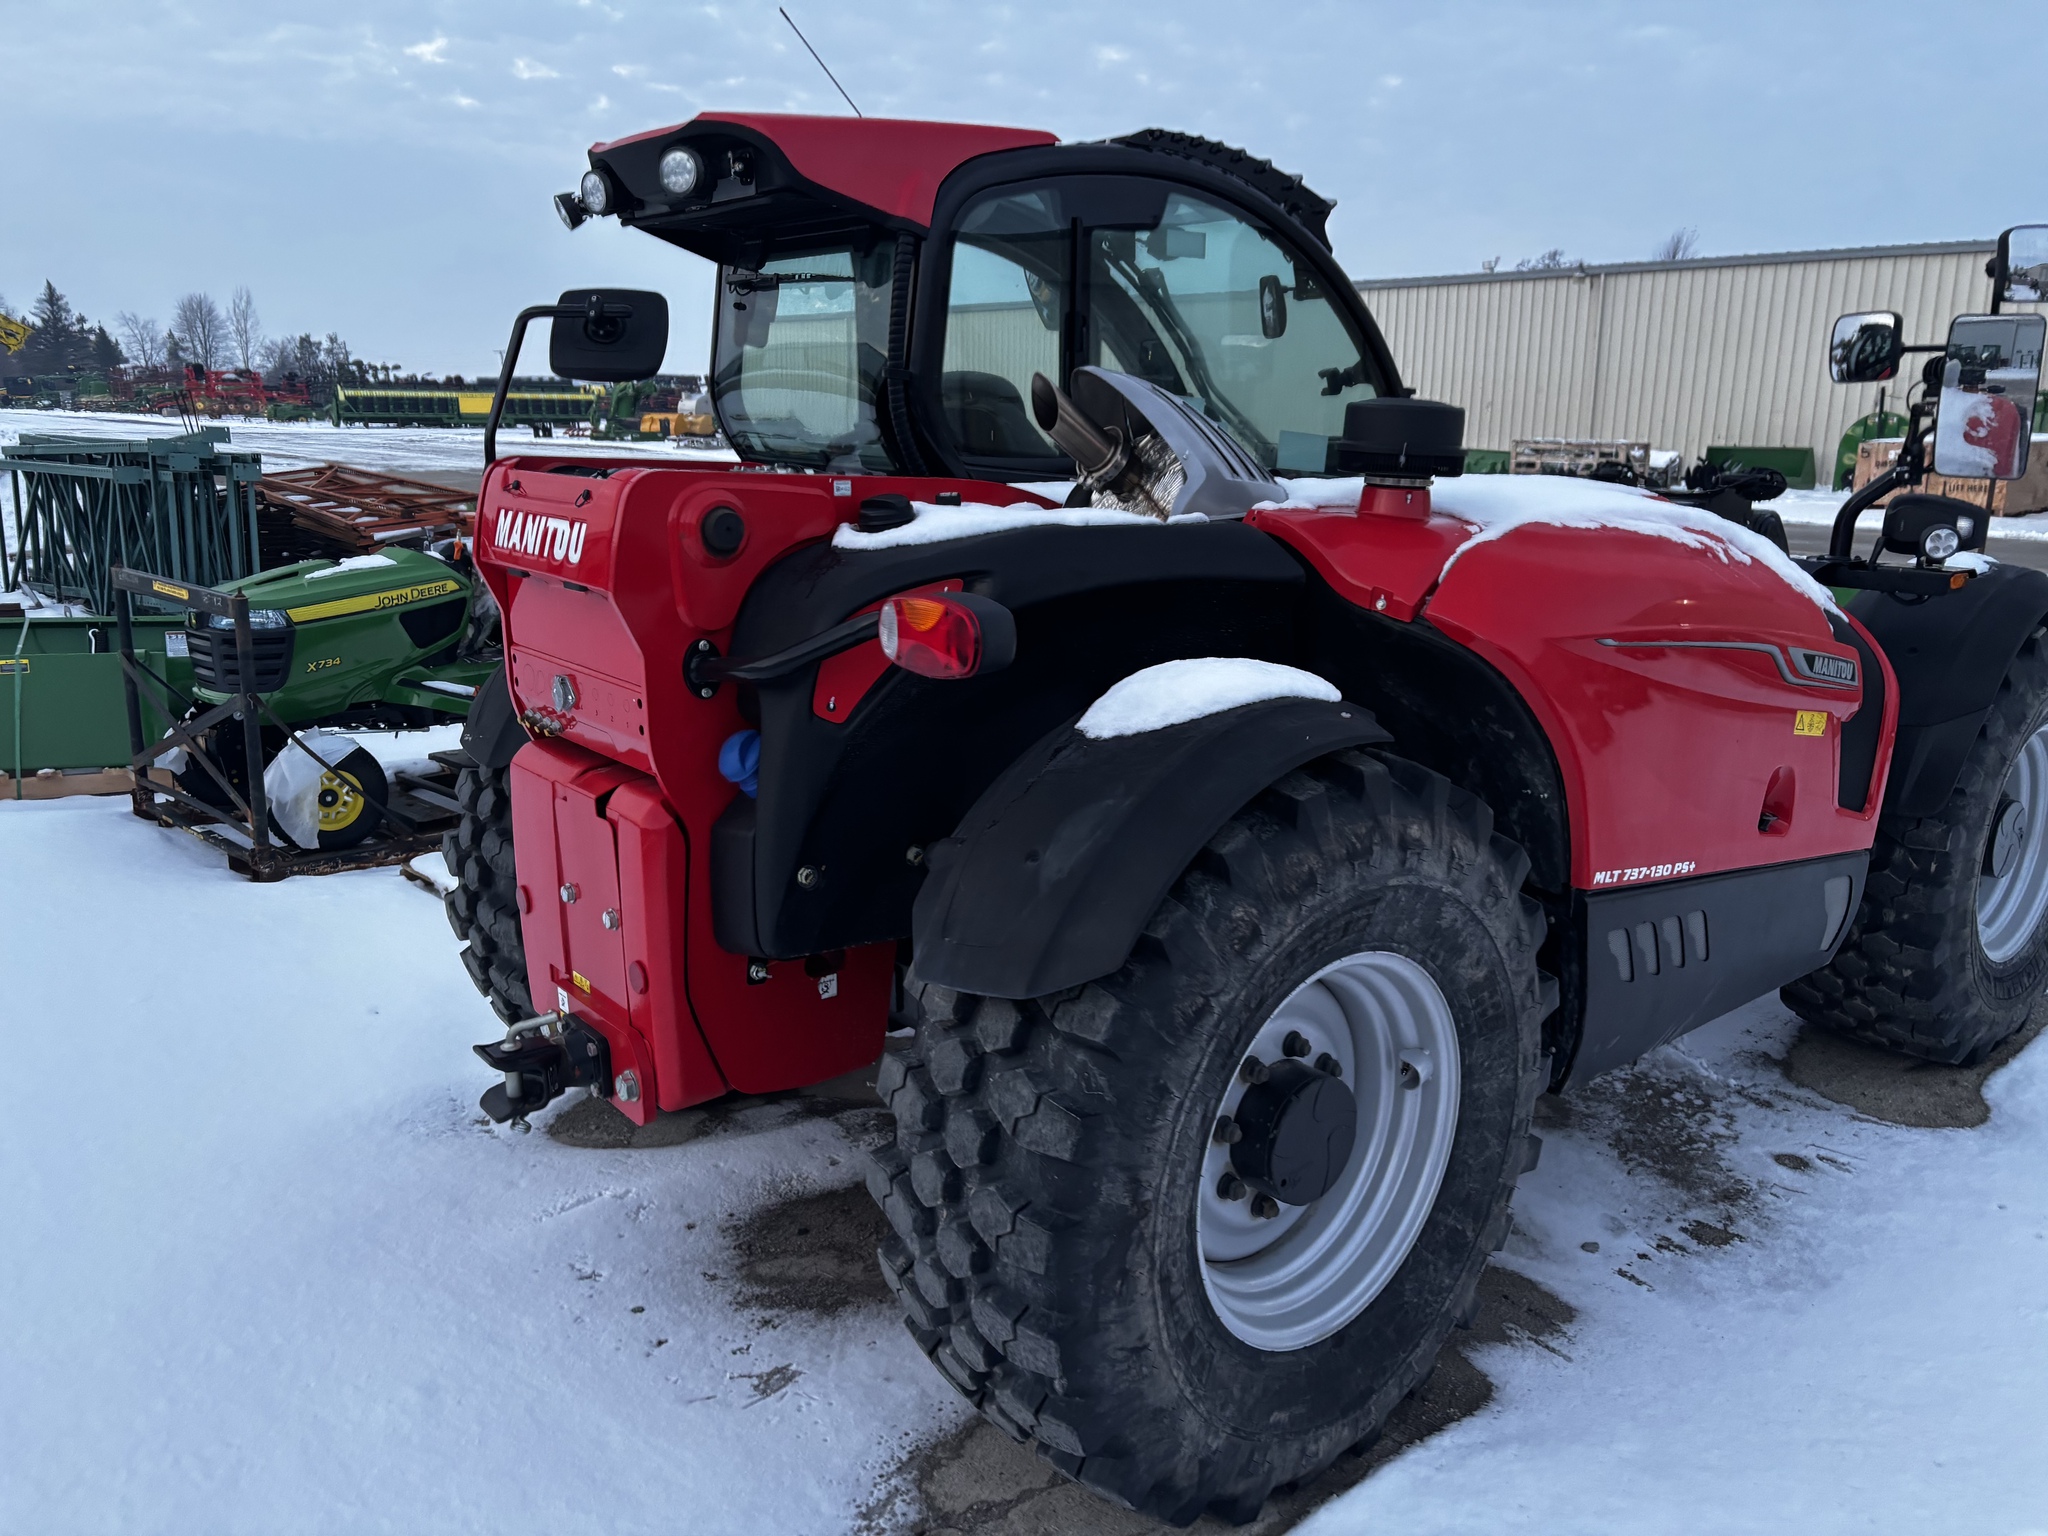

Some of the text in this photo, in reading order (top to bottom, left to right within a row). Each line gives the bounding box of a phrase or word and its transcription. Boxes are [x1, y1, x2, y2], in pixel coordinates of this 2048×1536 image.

[494, 508, 587, 565] MANITOU
[374, 583, 449, 609] JOHN DEERE
[306, 657, 341, 673] X734
[1812, 655, 1854, 680] MANITOU
[1593, 870, 1622, 885] MLT
[1673, 861, 1696, 875] PS+
